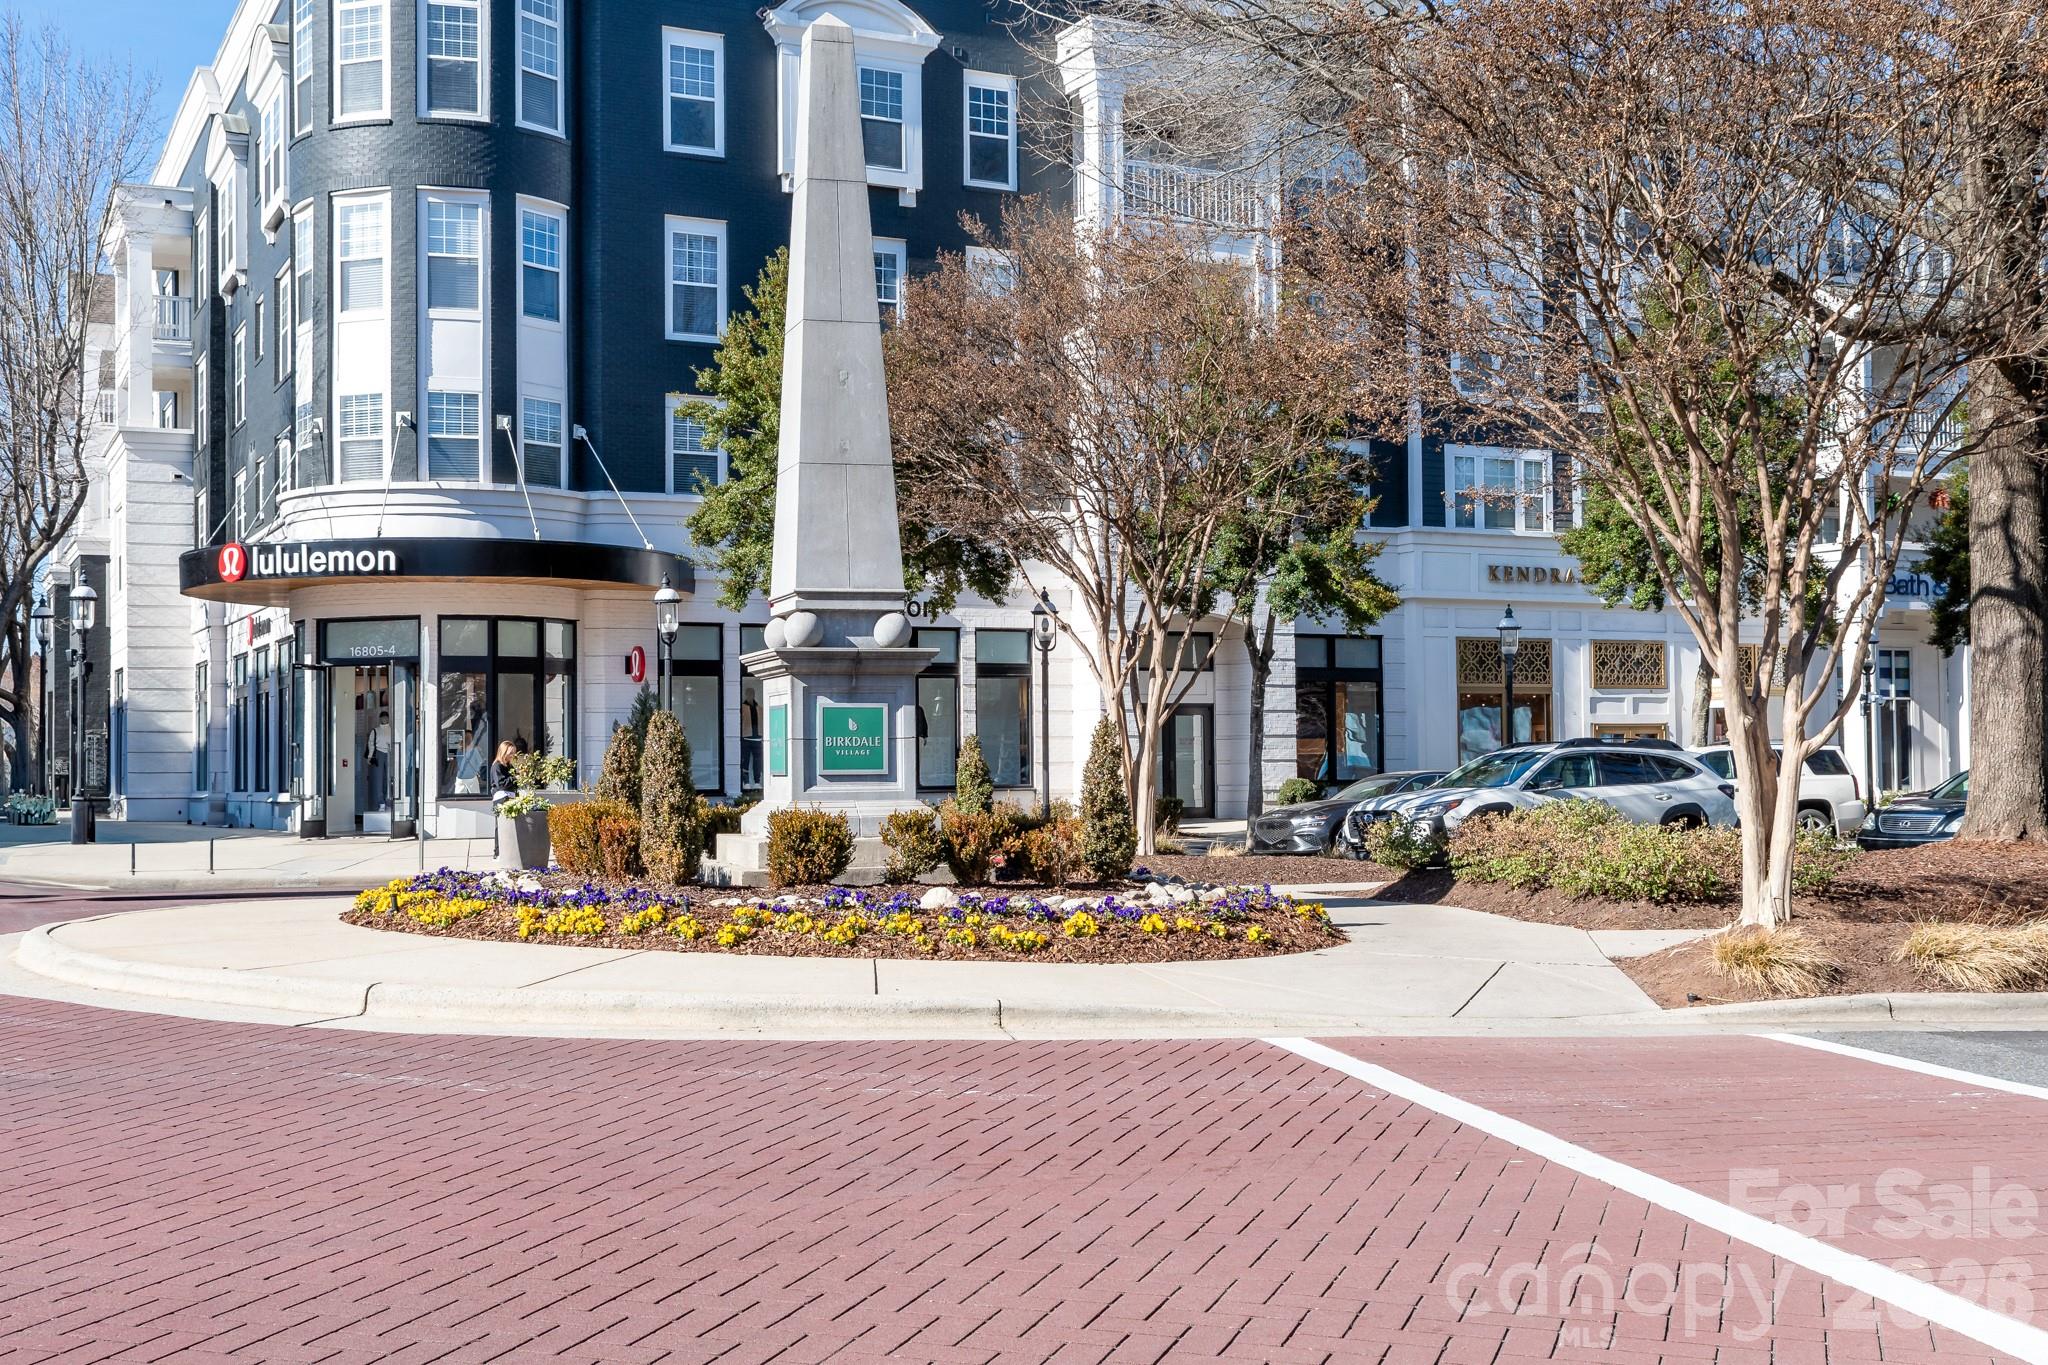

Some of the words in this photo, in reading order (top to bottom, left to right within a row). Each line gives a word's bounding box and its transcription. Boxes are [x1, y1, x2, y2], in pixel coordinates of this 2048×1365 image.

[252, 543, 396, 576] lululemon
[1488, 565, 1576, 584] KENDRA
[350, 645, 396, 657] 16805-4
[825, 736, 881, 747] BIRKDALE
